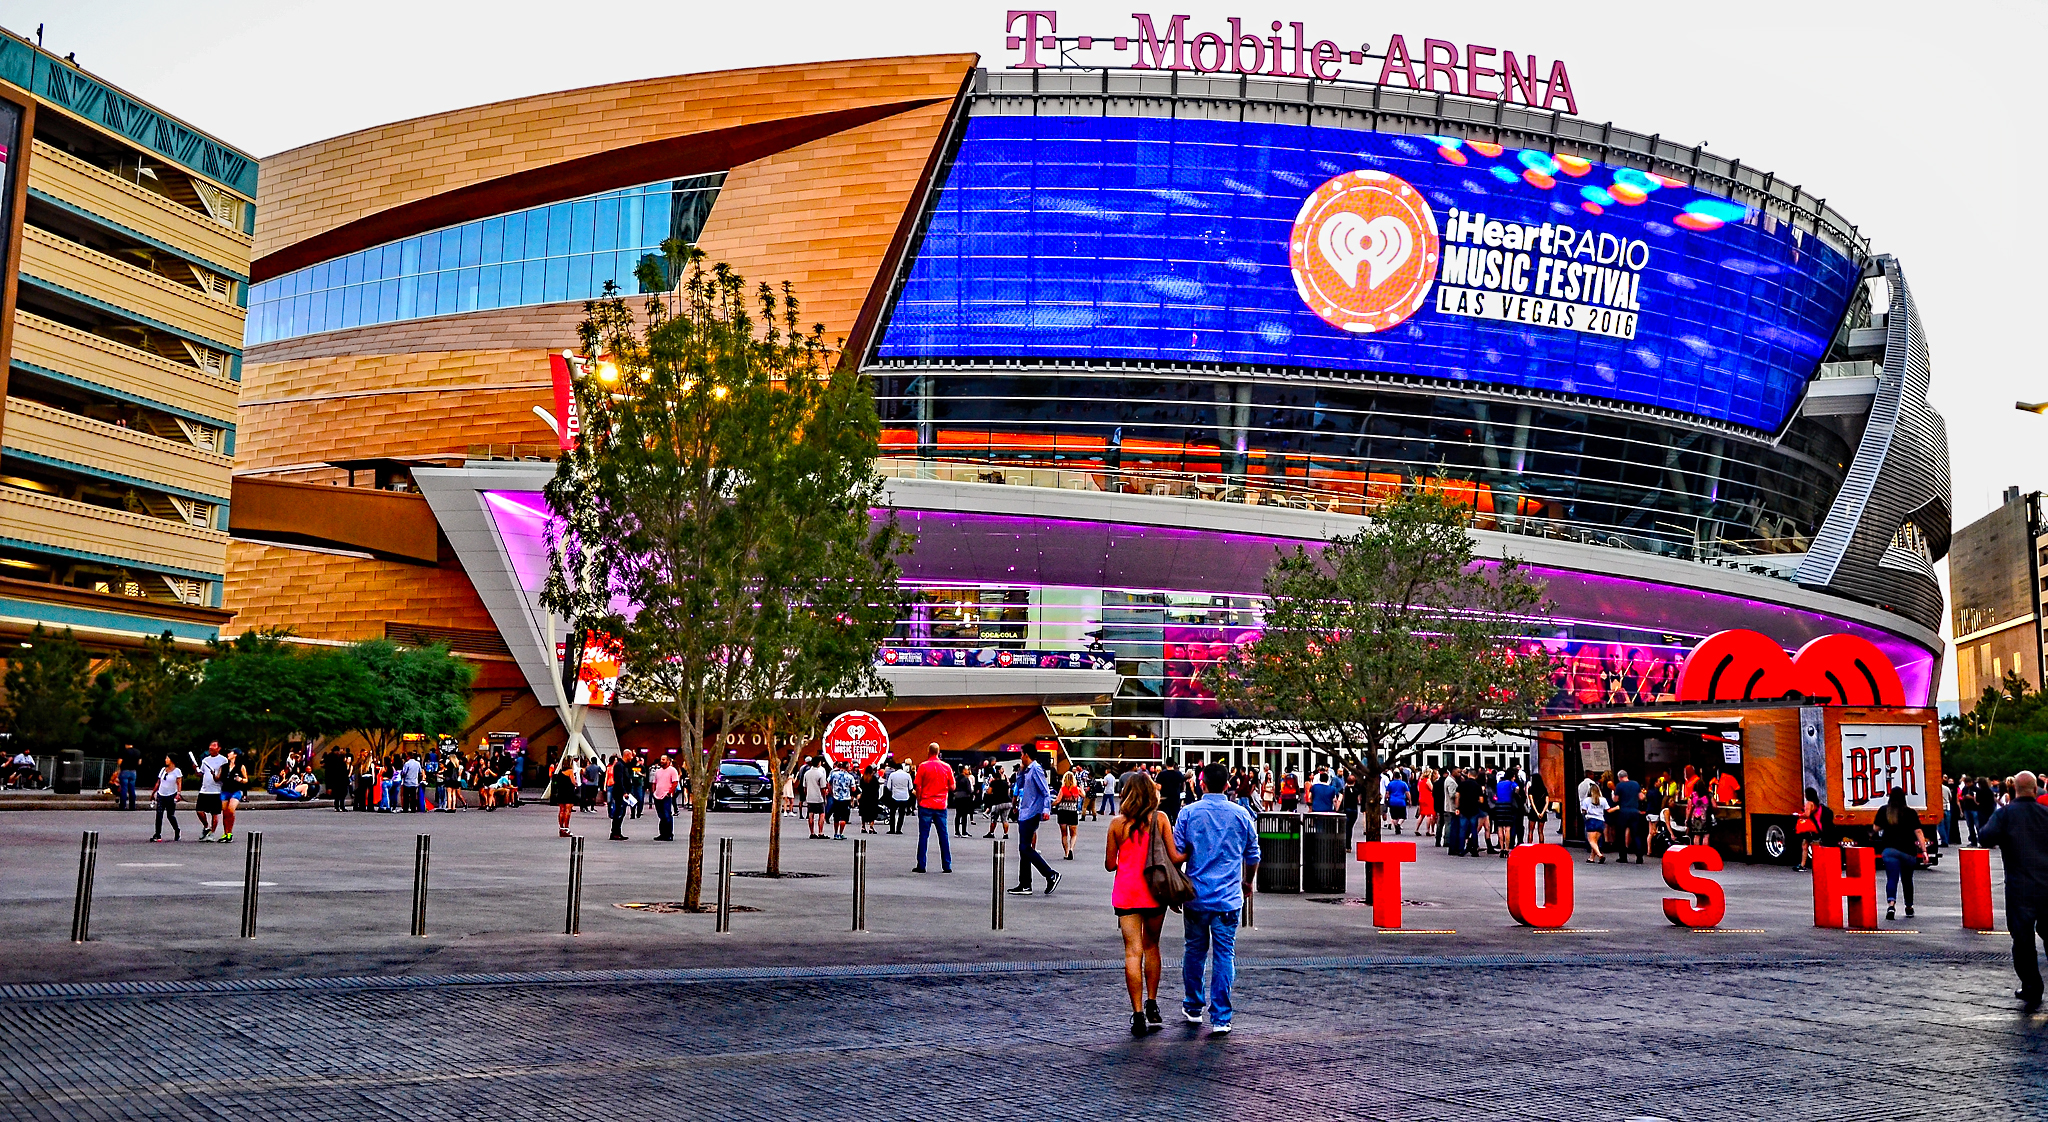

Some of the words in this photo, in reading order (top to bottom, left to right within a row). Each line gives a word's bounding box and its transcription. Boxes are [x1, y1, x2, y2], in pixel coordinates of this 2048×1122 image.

[1377, 34, 1577, 114] ARENA
[1445, 207, 1649, 271] iHeartRADIO
[1441, 244, 1531, 292] MUSIC
[1535, 257, 1640, 311] FESTIVAL
[1441, 289, 1485, 316] LAS
[1502, 295, 1575, 328] VEGAS
[1587, 308, 1634, 337] 2016
[980, 631, 1018, 639] COCA-COLA
[1847, 745, 1919, 806] BEER
